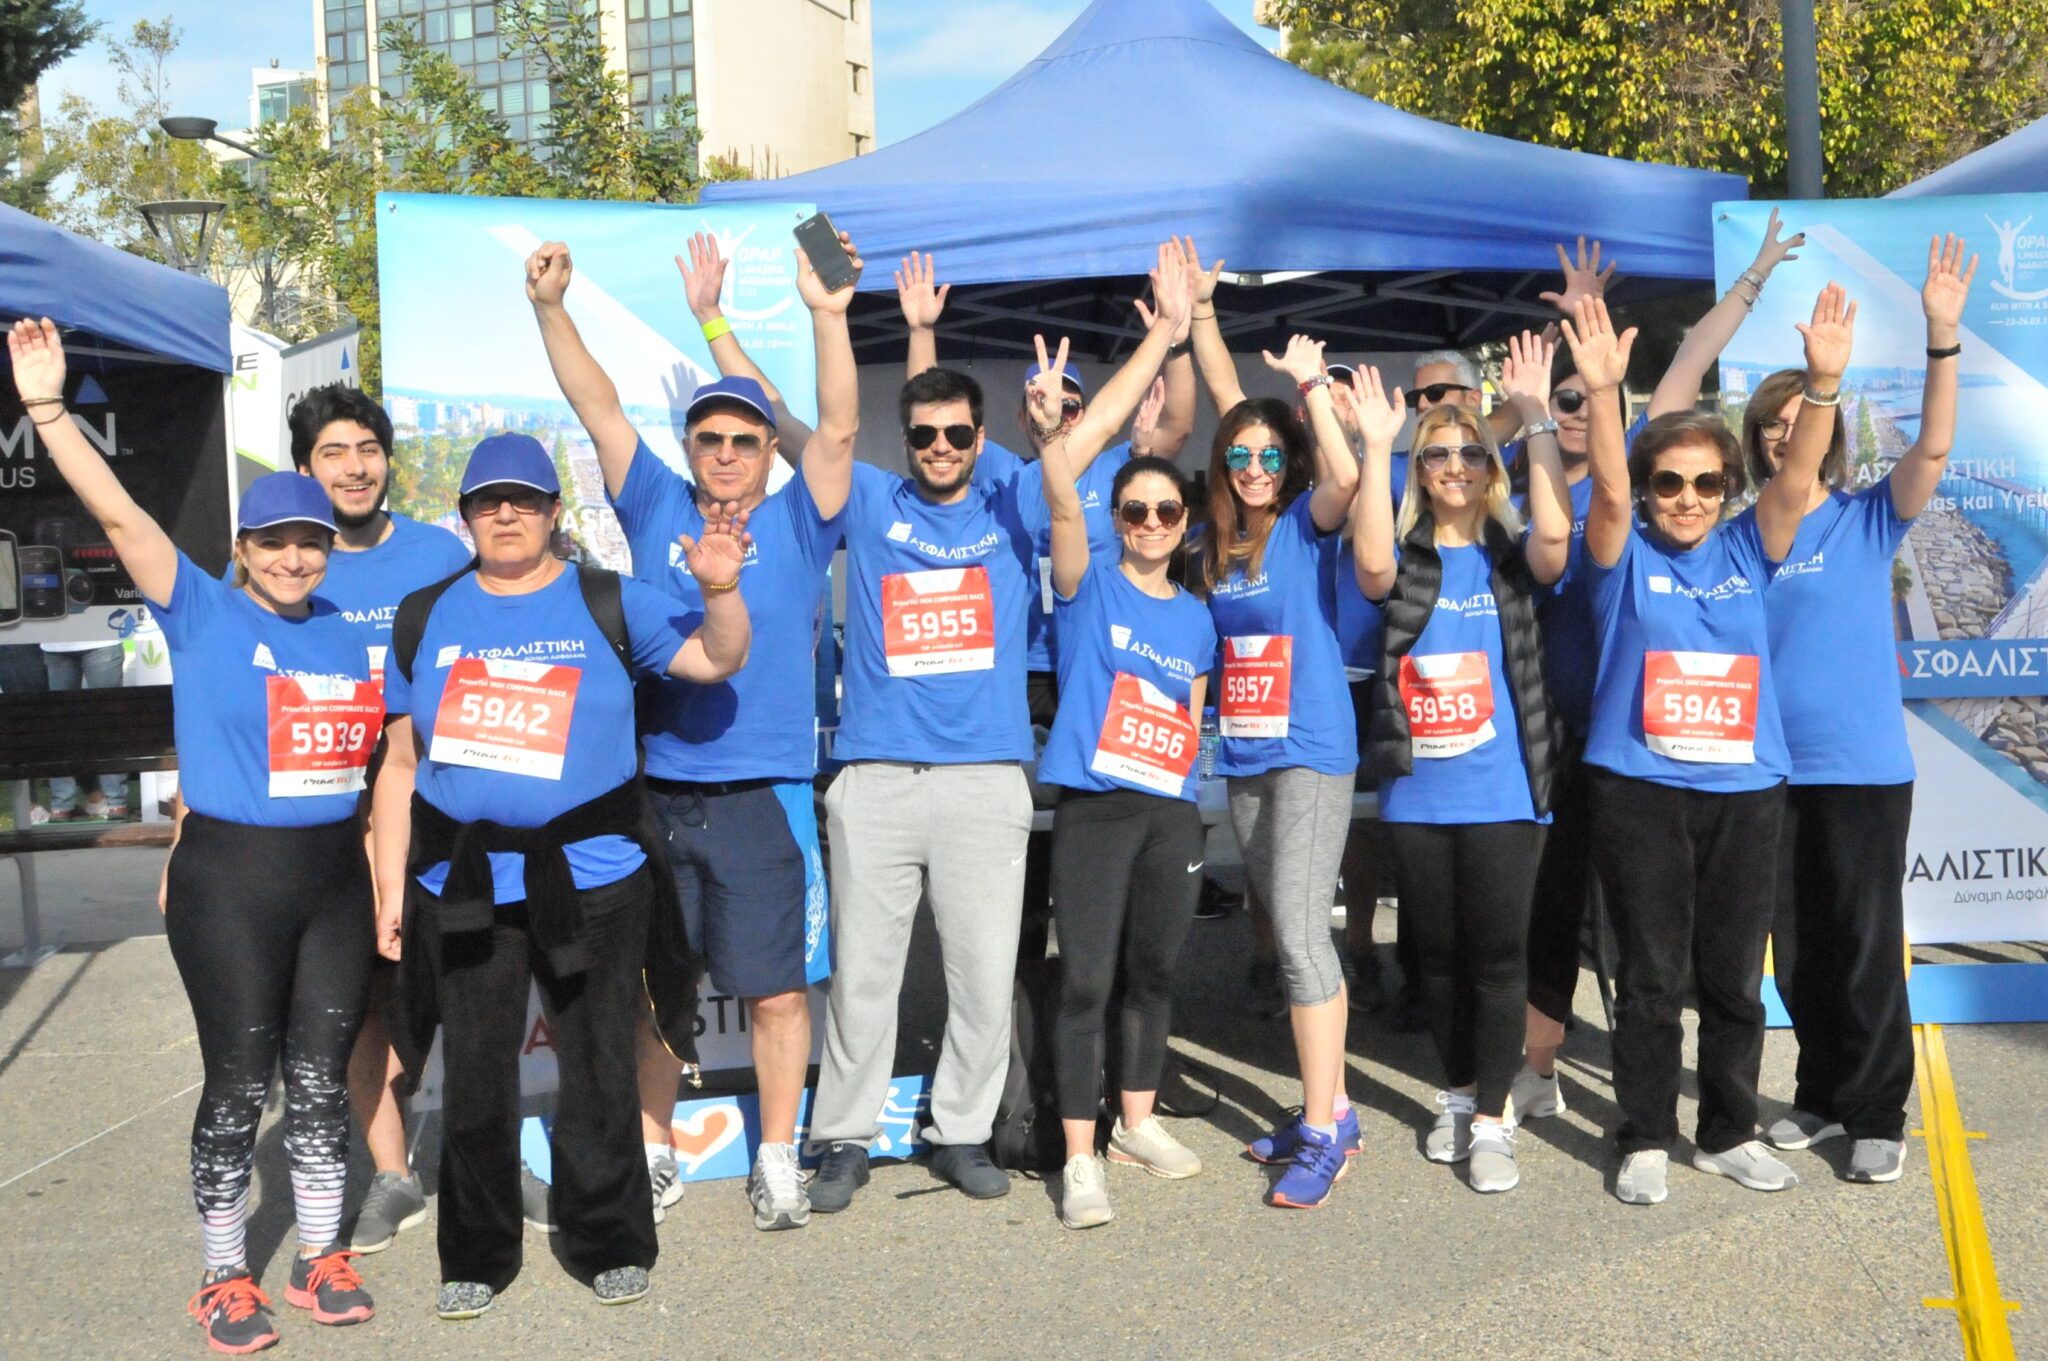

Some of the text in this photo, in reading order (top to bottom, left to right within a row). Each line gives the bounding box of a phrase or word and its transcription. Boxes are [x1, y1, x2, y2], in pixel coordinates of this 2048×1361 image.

[902, 608, 978, 641] 5955
[1227, 675, 1274, 703] 5957
[459, 693, 551, 736] 5942
[1410, 693, 1477, 723] 5958
[1663, 694, 1741, 726] 5943
[291, 721, 367, 755] 5939
[1119, 716, 1186, 759] 5956
[1954, 889, 2003, 904] Δύναμη
